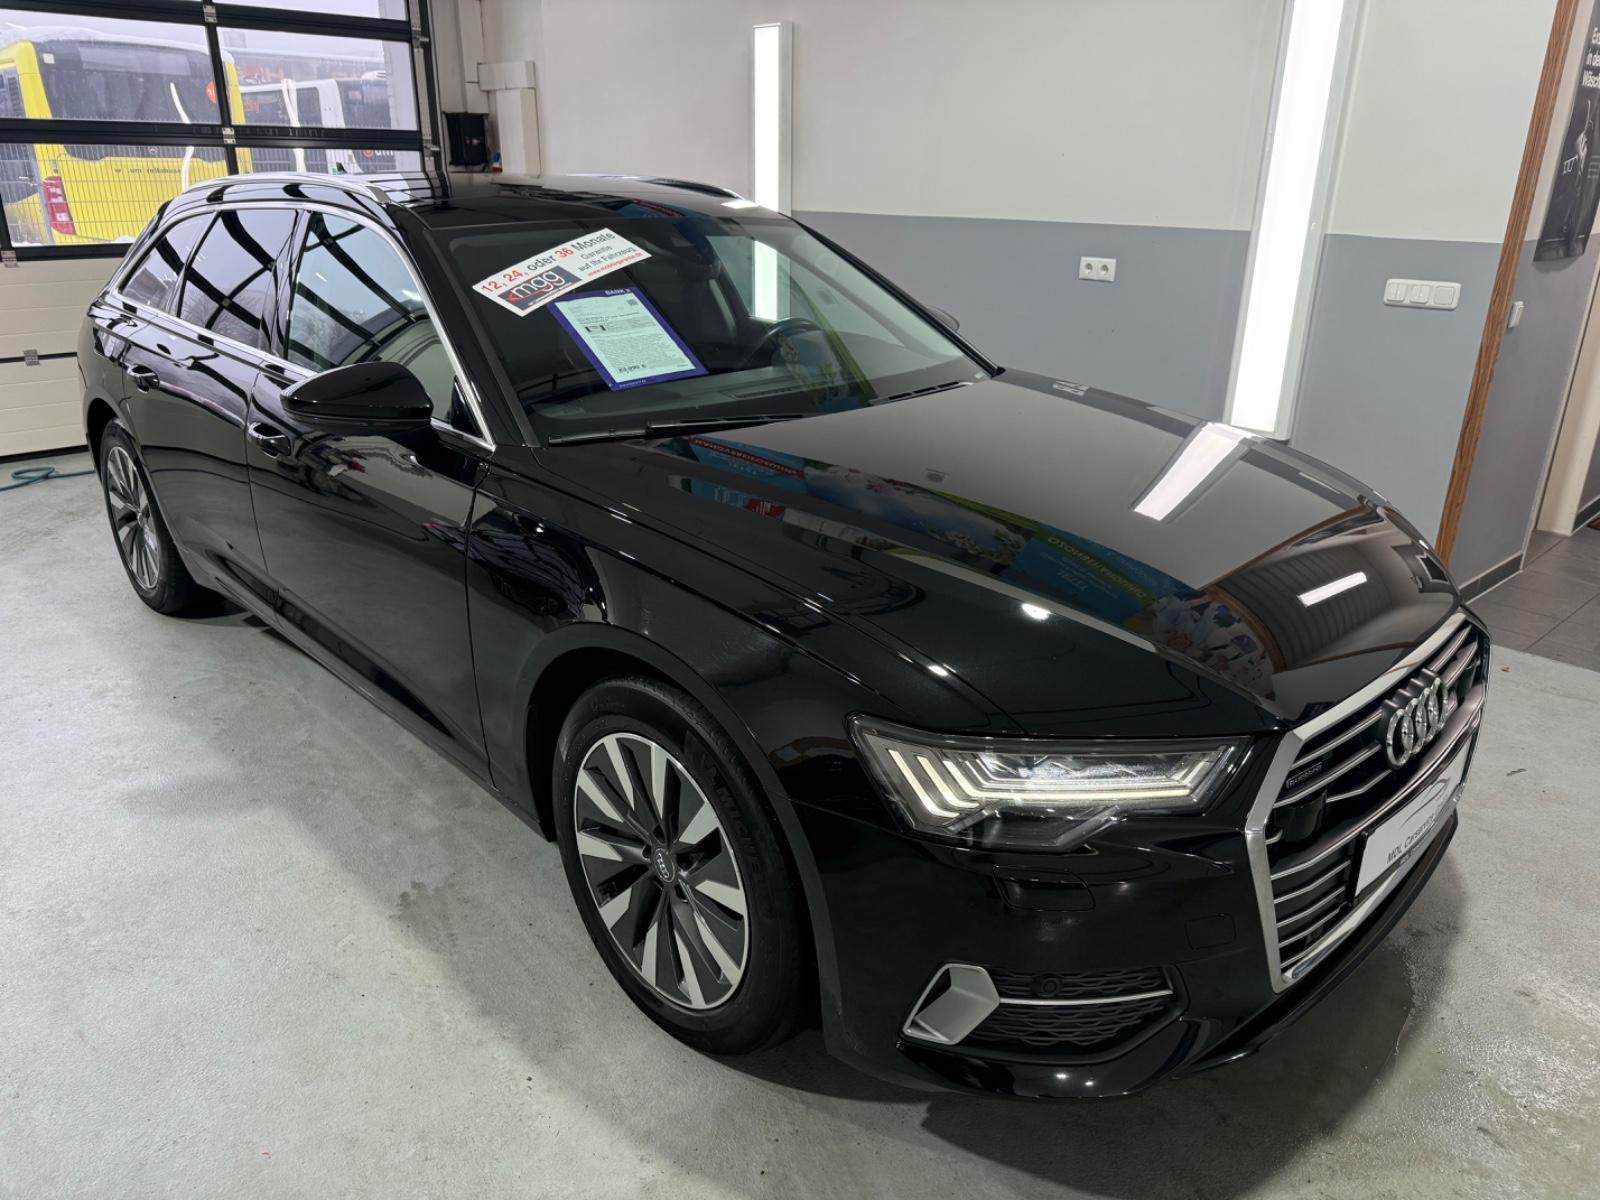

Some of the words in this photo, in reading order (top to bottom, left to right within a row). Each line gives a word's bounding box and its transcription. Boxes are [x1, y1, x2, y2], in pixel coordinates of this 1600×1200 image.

[481, 280, 507, 293] 12,
[503, 270, 529, 282] 24,
[527, 254, 557, 271] oder
[554, 247, 574, 258] 36
[571, 233, 616, 251] Monate
[511, 271, 566, 298] mgg
